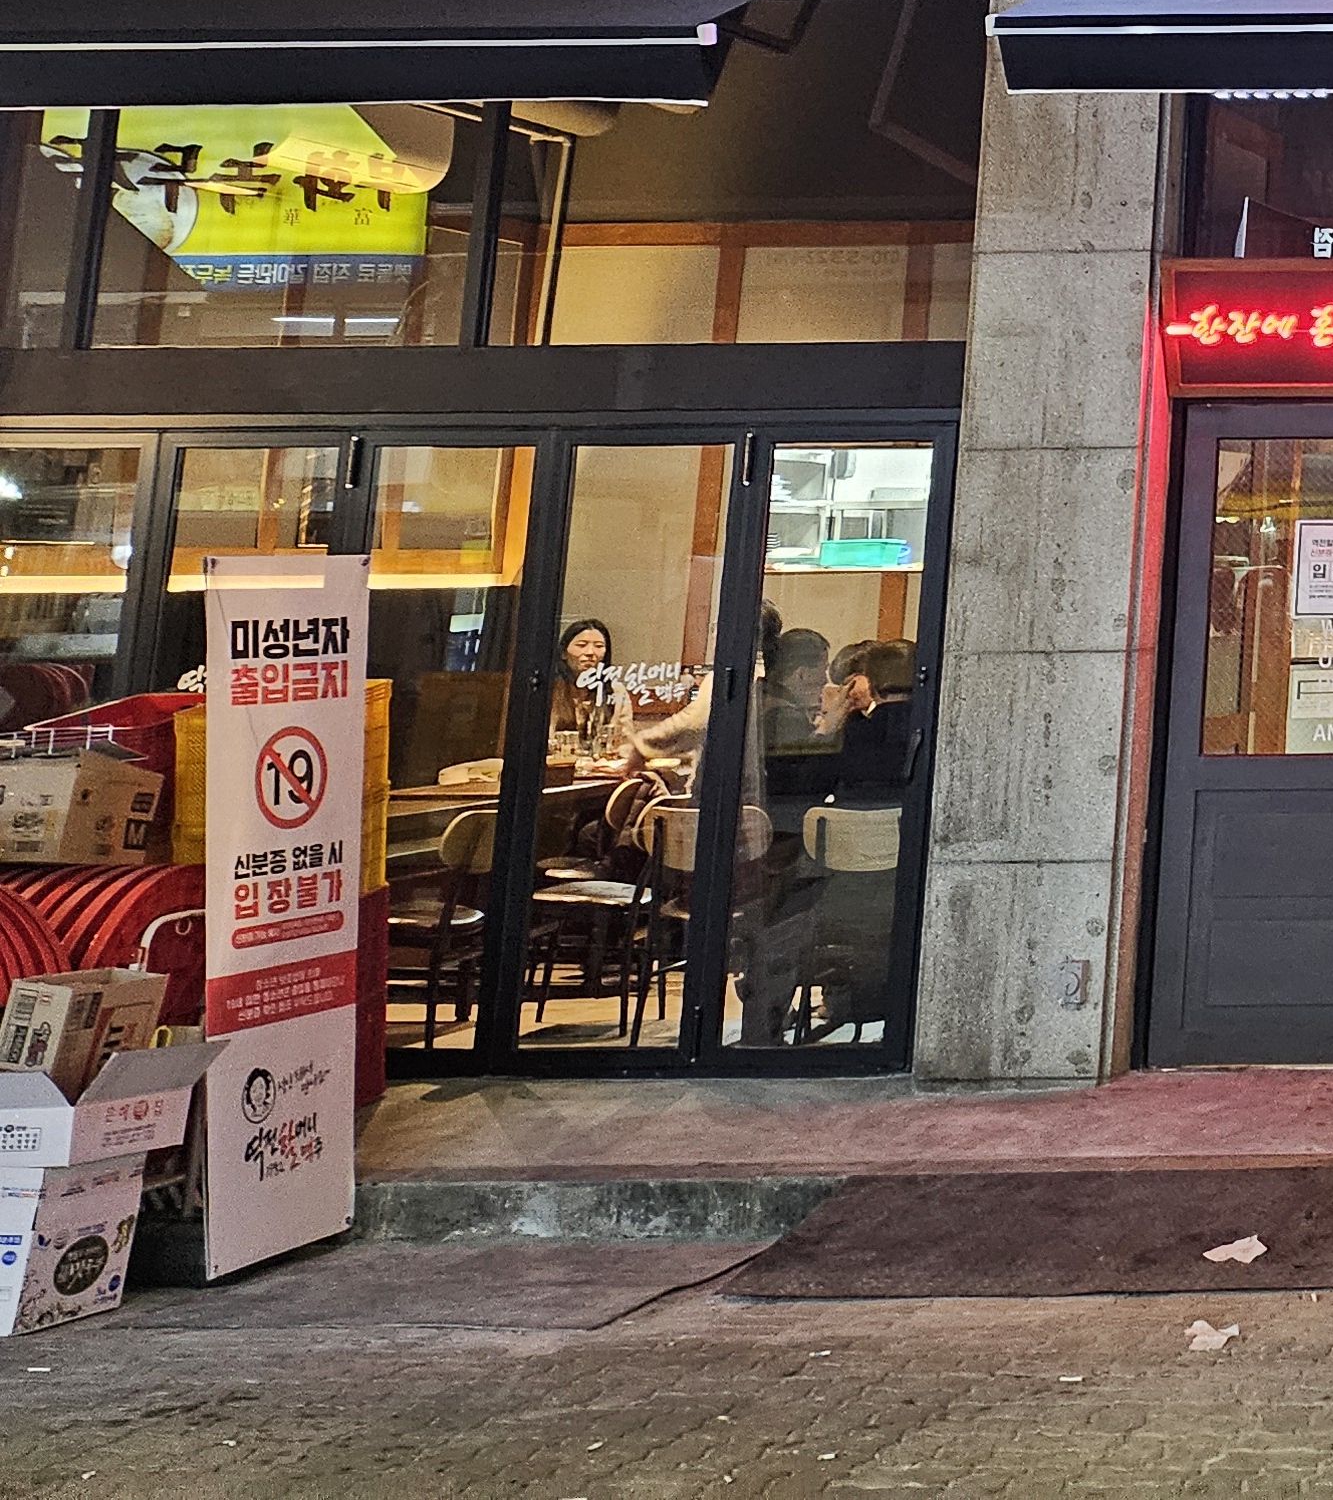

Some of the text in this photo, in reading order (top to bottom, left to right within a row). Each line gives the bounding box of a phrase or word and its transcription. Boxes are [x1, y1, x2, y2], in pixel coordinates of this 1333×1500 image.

[231, 617, 350, 660] 미성년자
[230, 661, 348, 706] 출입금지
[266, 749, 315, 807] 19
[234, 839, 344, 881] 신분증 없을 시
